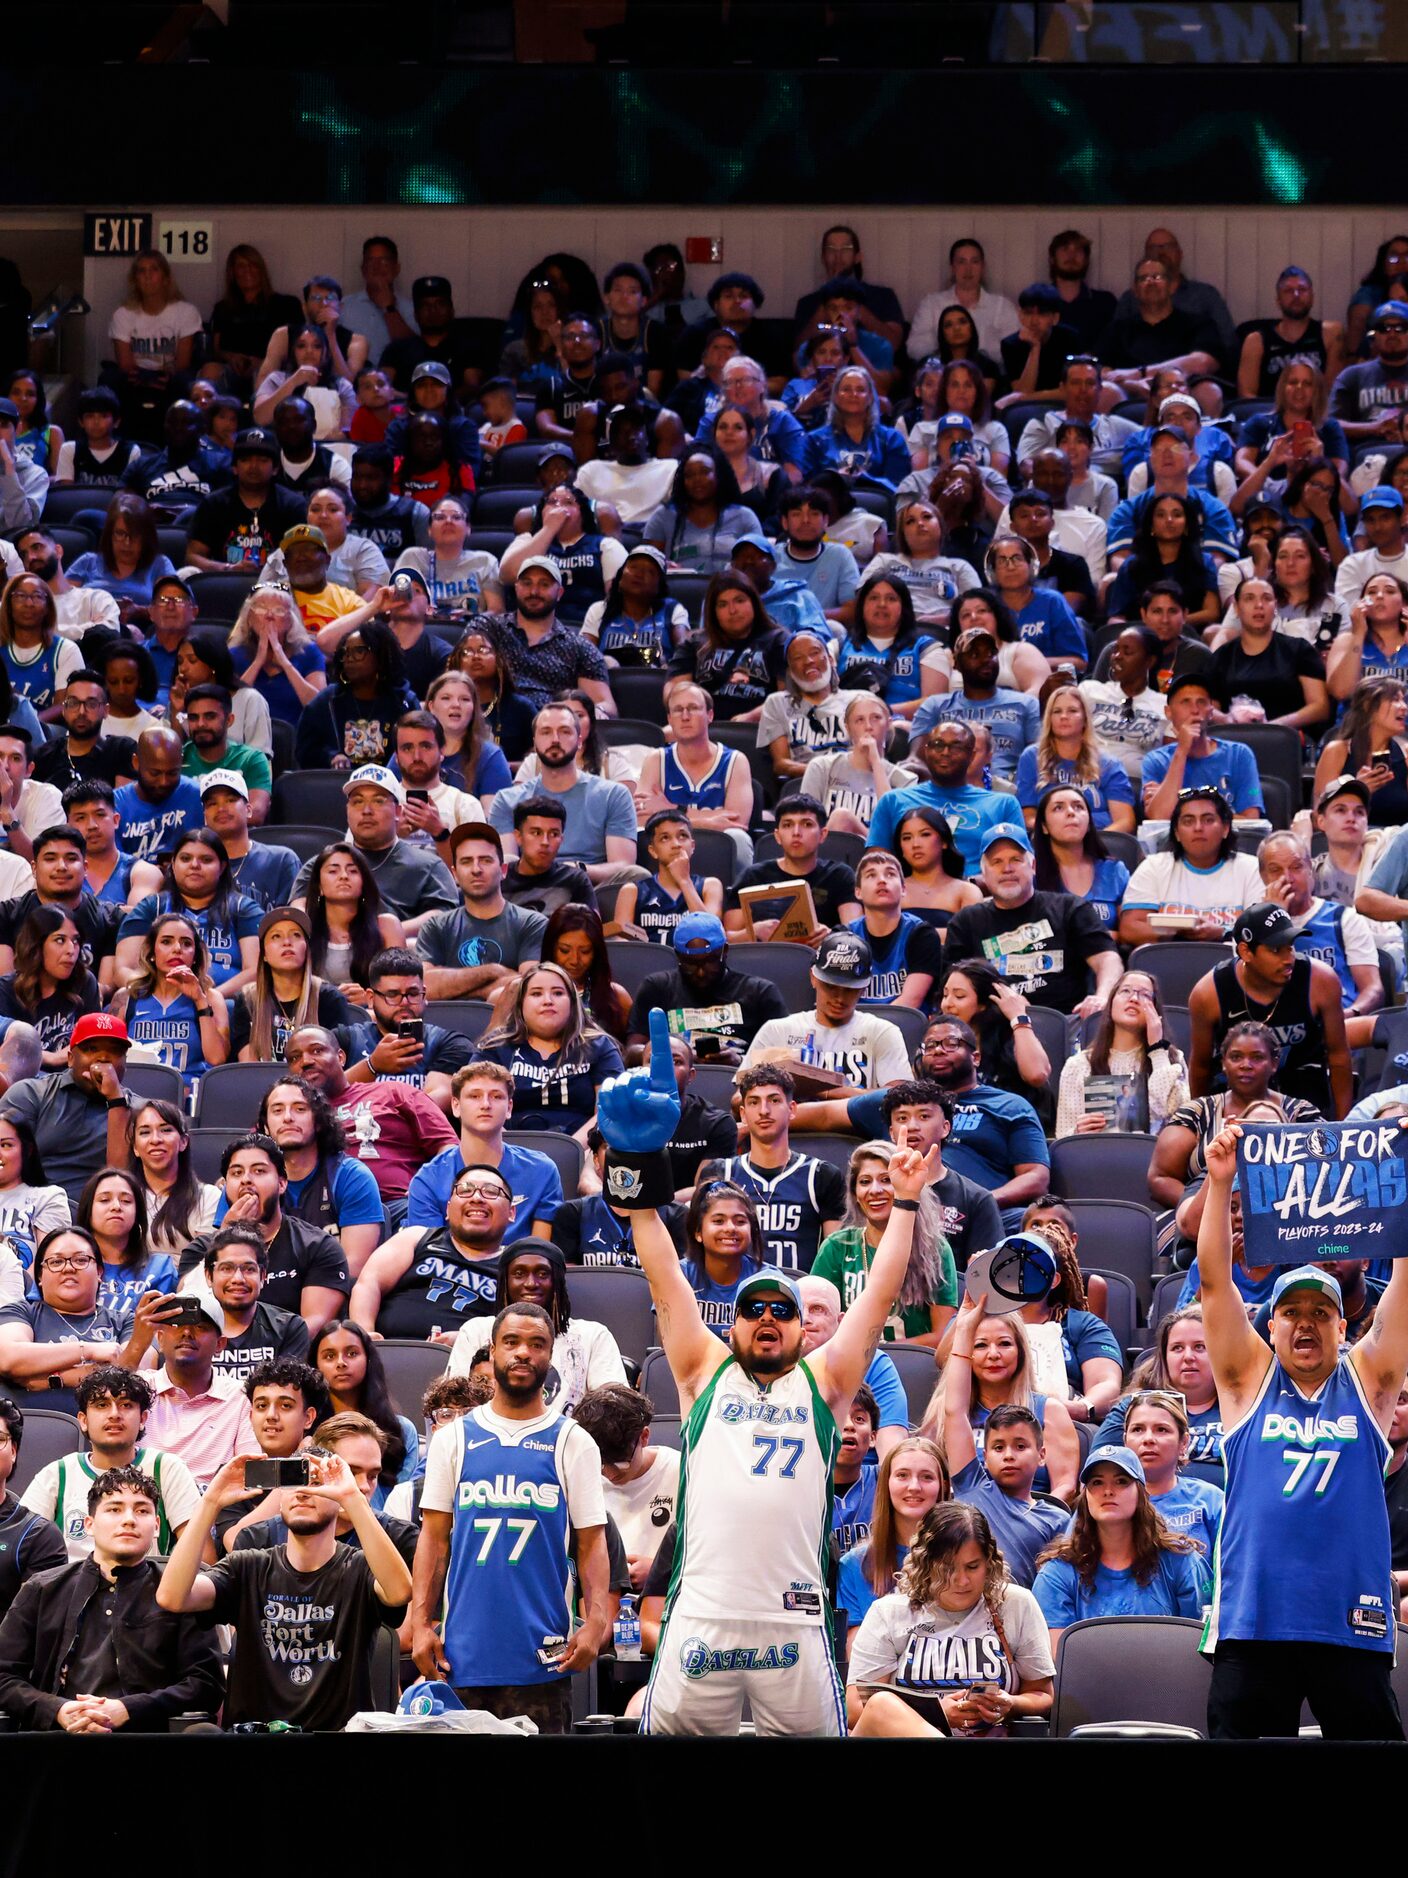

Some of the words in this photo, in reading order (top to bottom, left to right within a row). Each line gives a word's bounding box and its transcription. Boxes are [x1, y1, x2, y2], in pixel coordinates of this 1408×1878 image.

[94, 218, 143, 252] EXIT
[162, 230, 209, 255] 118
[1020, 622, 1045, 640] FOR
[821, 950, 860, 970] Finals
[132, 1021, 189, 1042] DALLAS
[674, 1140, 707, 1149] ANGELES
[1243, 1130, 1306, 1165] ONE
[1340, 1126, 1400, 1163] FOR
[1272, 1161, 1366, 1220] ALL
[1278, 1225, 1330, 1241] PLAYOFFS
[1332, 1222, 1384, 1236] 2023-24
[1317, 1243, 1350, 1255] chime
[416, 1256, 497, 1302] MAVS
[426, 1279, 479, 1312] 77
[721, 1402, 809, 1425] DALLAS
[1263, 1413, 1357, 1446] Dallas
[522, 1438, 555, 1453] chime
[750, 1434, 805, 1480] 77
[1282, 1449, 1340, 1498] 77
[459, 1474, 560, 1512] Dallas
[473, 1517, 538, 1567] 77
[263, 1600, 335, 1623] Dallas
[261, 1618, 313, 1642] Fort
[267, 1637, 341, 1663] Worth
[684, 1642, 801, 1672] DALLAS
[898, 1634, 1004, 1681] FINALS
